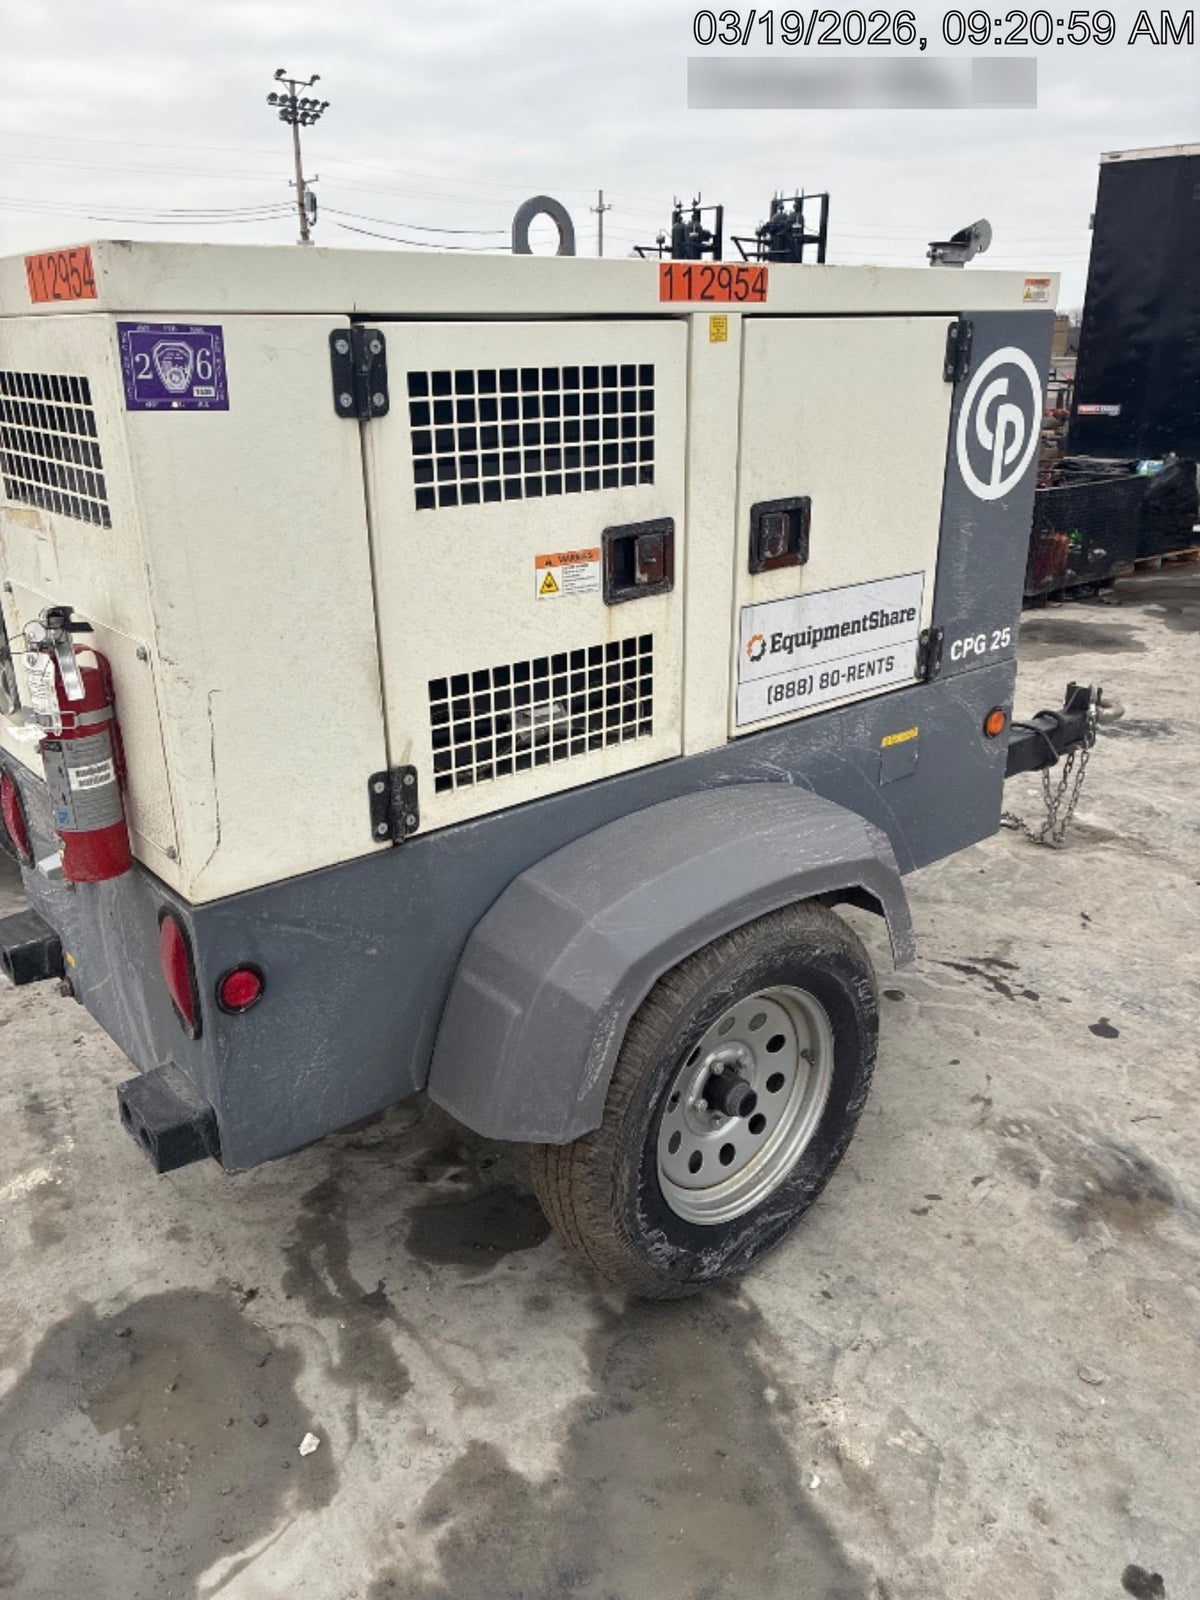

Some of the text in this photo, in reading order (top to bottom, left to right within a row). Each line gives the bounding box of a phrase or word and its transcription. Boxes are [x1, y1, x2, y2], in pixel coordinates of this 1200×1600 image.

[27, 248, 95, 300] 112954
[664, 265, 766, 301] 112954
[770, 607, 916, 654] EquipmentShare
[951, 627, 1011, 660] CPG 25
[768, 656, 895, 704] (888) 80-RENTS
